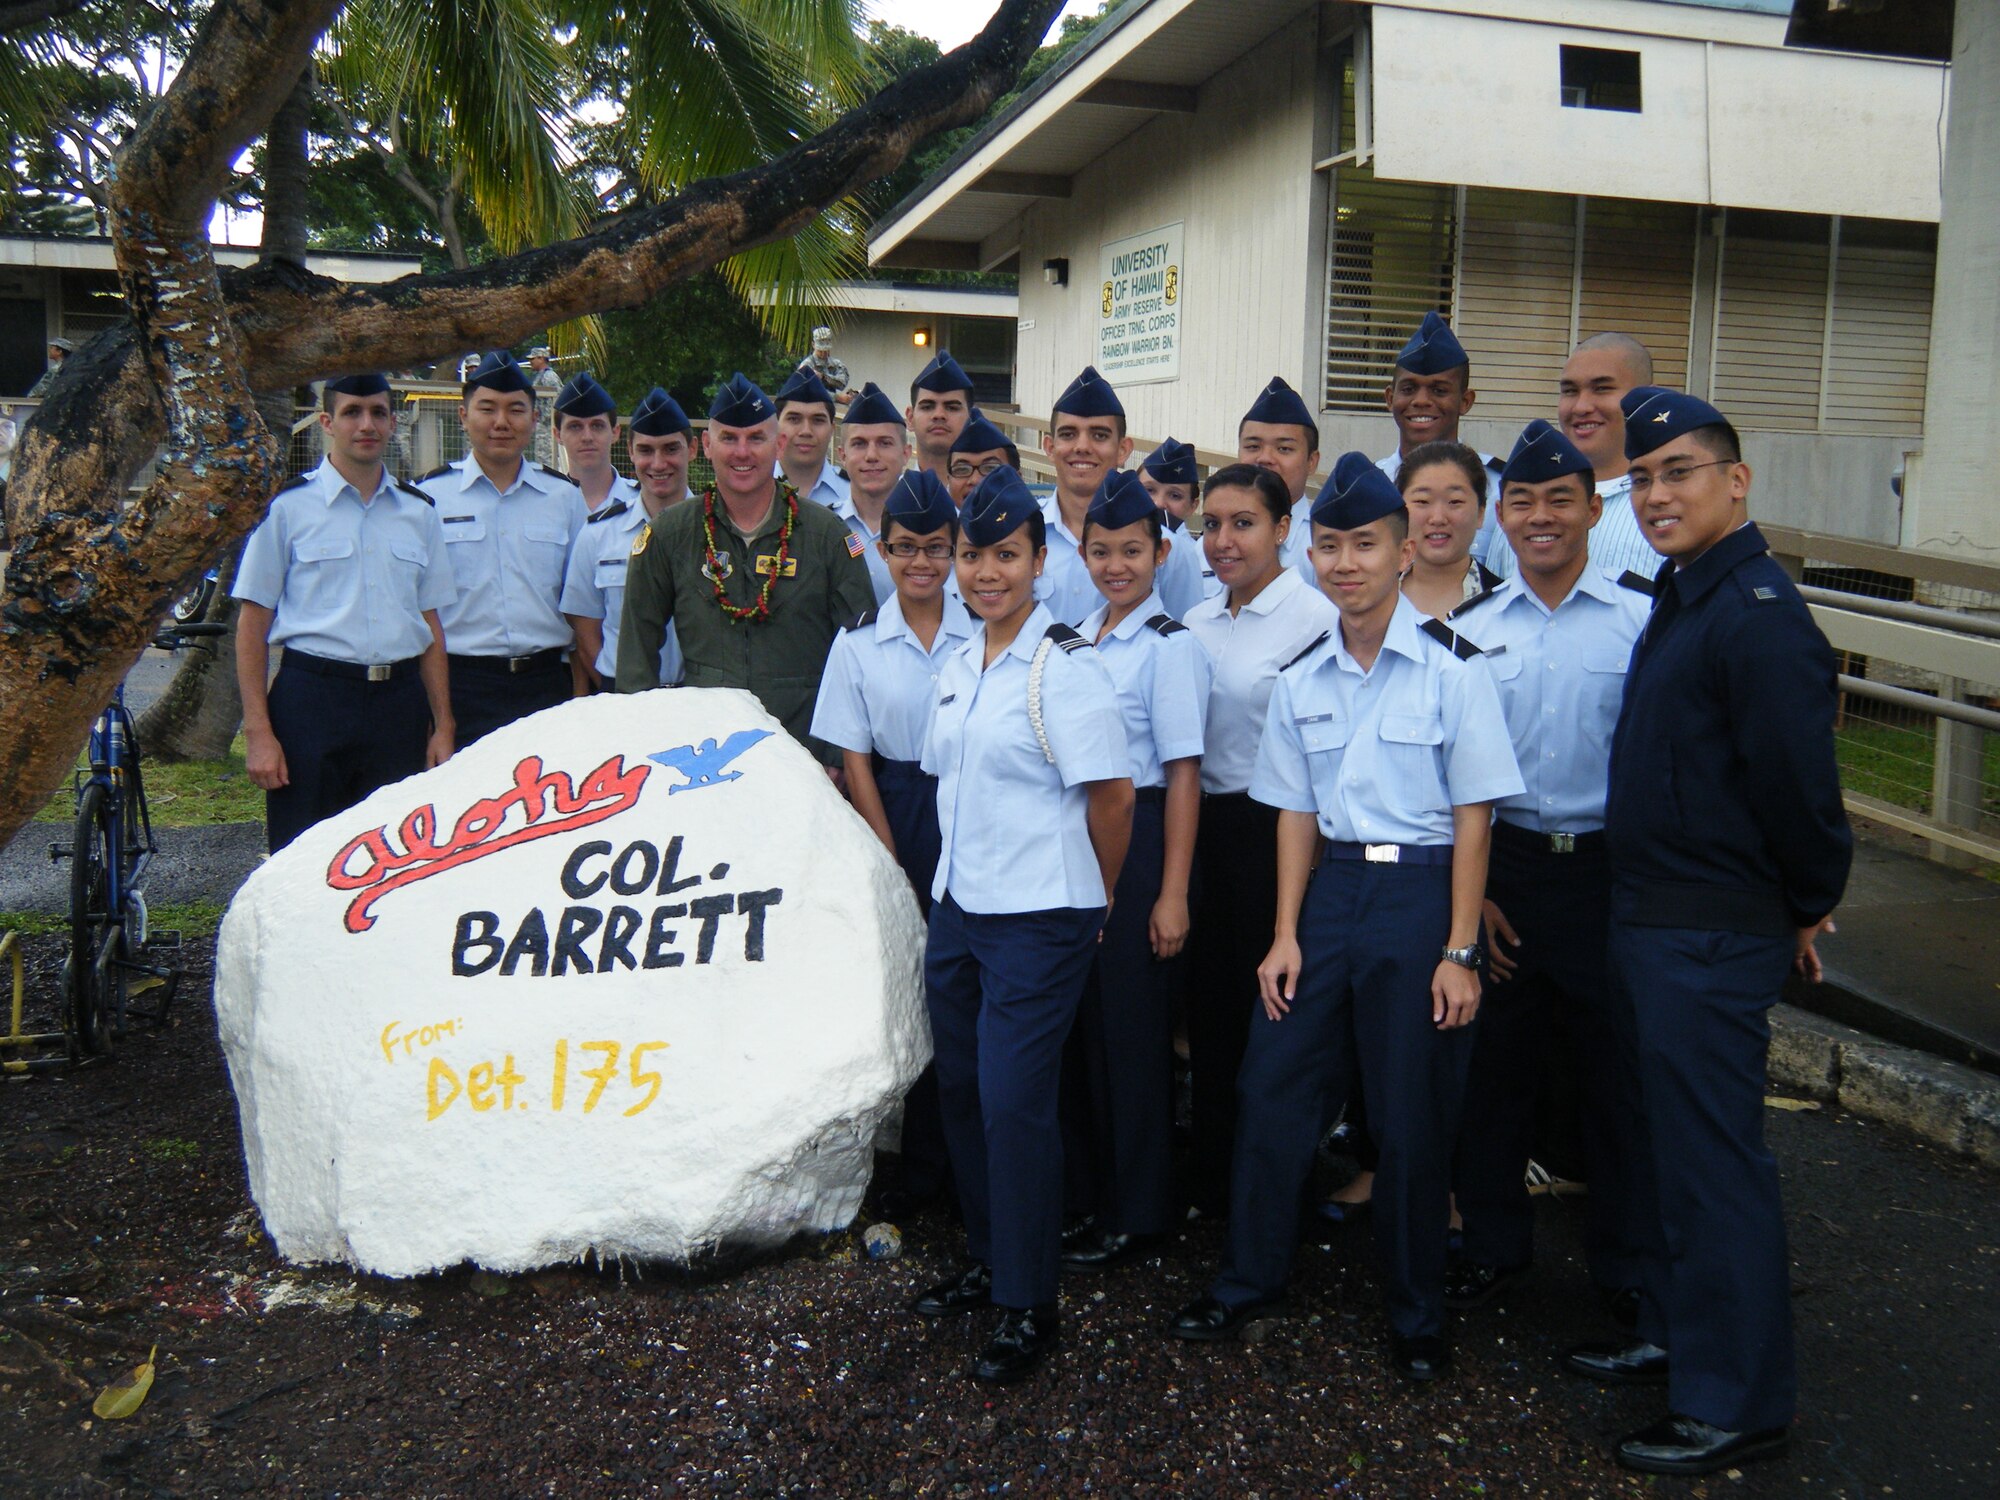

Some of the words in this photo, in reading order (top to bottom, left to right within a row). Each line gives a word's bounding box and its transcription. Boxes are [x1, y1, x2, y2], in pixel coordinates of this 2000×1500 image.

[1112, 243, 1169, 277] UNIVERSITY
[1114, 279, 1128, 301] OF
[1131, 270, 1164, 297] HAWAII
[1114, 304, 1131, 320] ARMY
[1133, 297, 1162, 316] RESERVE
[1101, 324, 1126, 341] OFFICER
[1128, 319, 1146, 336] TRNG.
[1148, 312, 1176, 332] CORPS
[1102, 341, 1130, 359] RAINBOW
[1131, 336, 1160, 354] WARRIOR
[1162, 335, 1174, 350] BN.
[560, 836, 731, 900] COL.
[452, 888, 784, 978] BARRETT
[426, 1053, 528, 1121] Det.
[551, 1038, 670, 1118] 175
